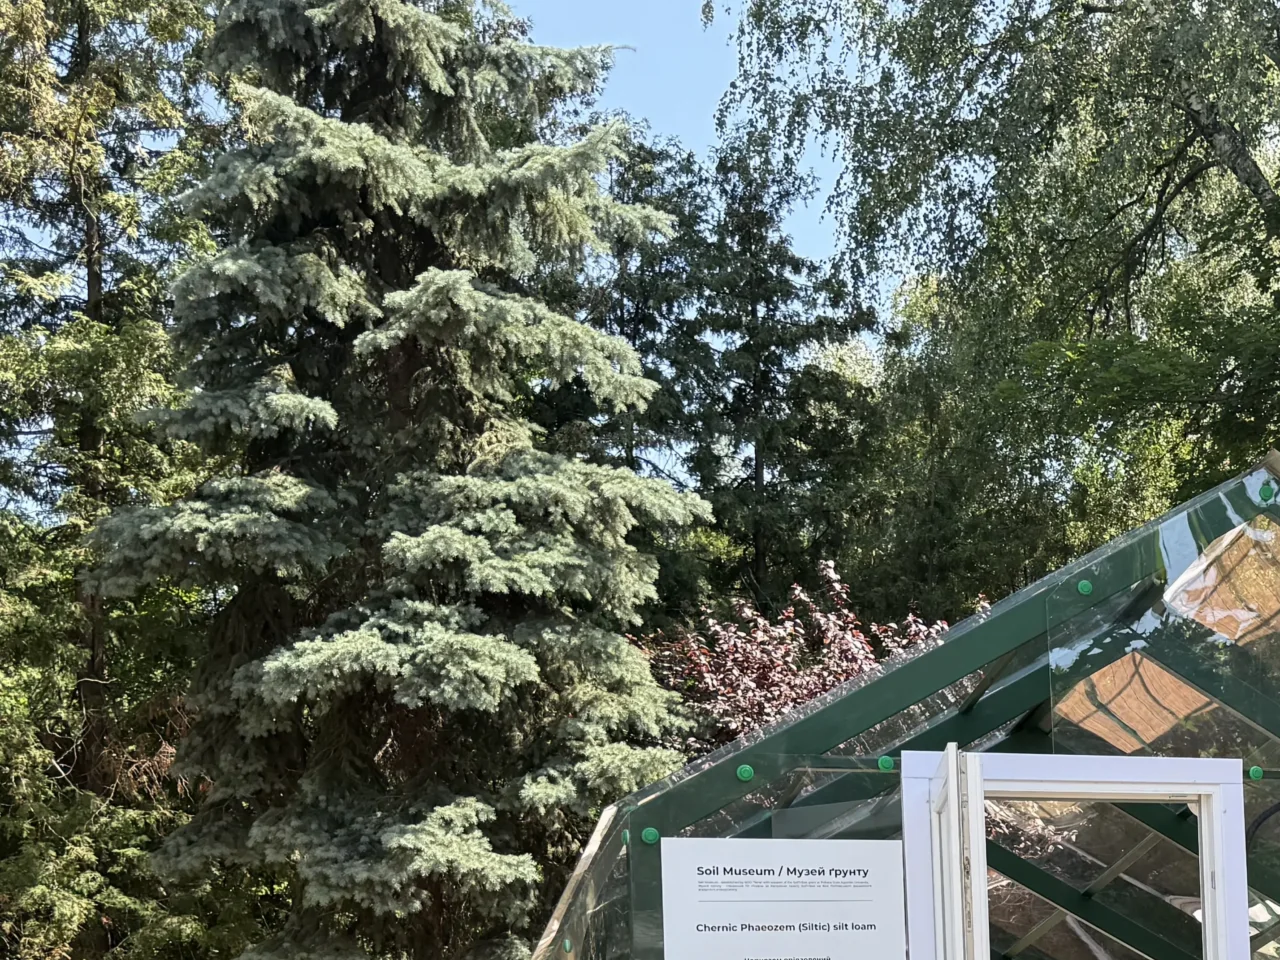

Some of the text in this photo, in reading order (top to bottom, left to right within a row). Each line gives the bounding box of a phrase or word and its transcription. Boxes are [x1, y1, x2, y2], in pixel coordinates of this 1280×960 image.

[696, 865, 869, 878] Soil Museum / Музей ґрунту
[696, 922, 877, 933] Chernic Phaeozem (Siltic) silt loam
